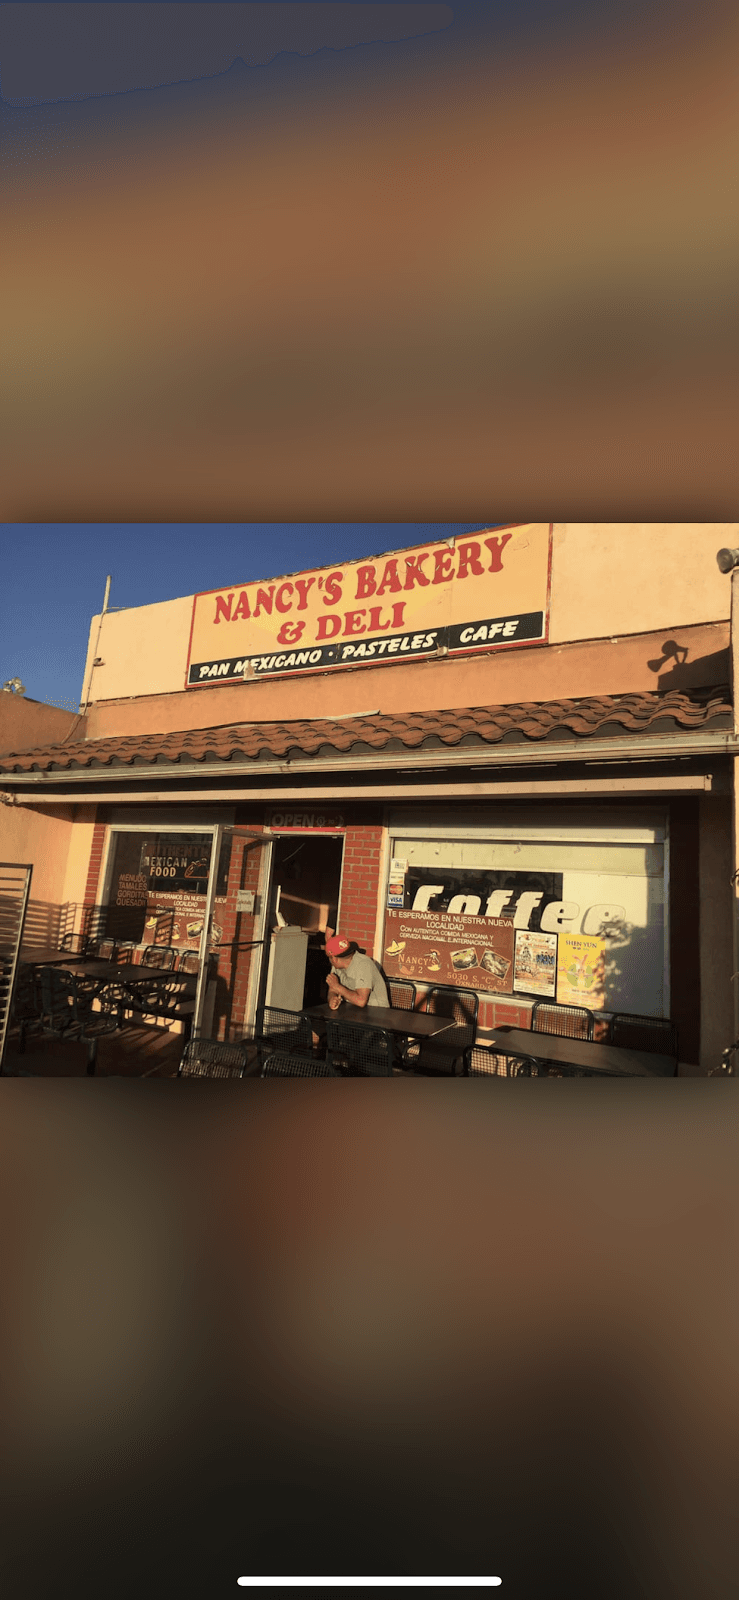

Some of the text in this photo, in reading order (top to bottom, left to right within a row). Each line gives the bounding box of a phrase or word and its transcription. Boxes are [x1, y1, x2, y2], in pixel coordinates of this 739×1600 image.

[213, 533, 513, 625] NANCY'S BAKERY
[276, 601, 407, 645] & DELI
[199, 620, 520, 679] PAN MEXICANO PASTELES CAFE
[271, 813, 315, 828] OPEN
[118, 873, 147, 883] MENUDO
[149, 866, 177, 878] FOOD
[118, 881, 148, 891] TAMALES
[411, 884, 627, 936] Coffee
[387, 907, 513, 928] TE ESPERAMOS EN NUESTRA NUEVA
[426, 921, 465, 931] LOCALIDAD
[583, 941, 597, 949] YUN
[398, 953, 436, 966] NANCY'S
[446, 971, 469, 981] 5030
